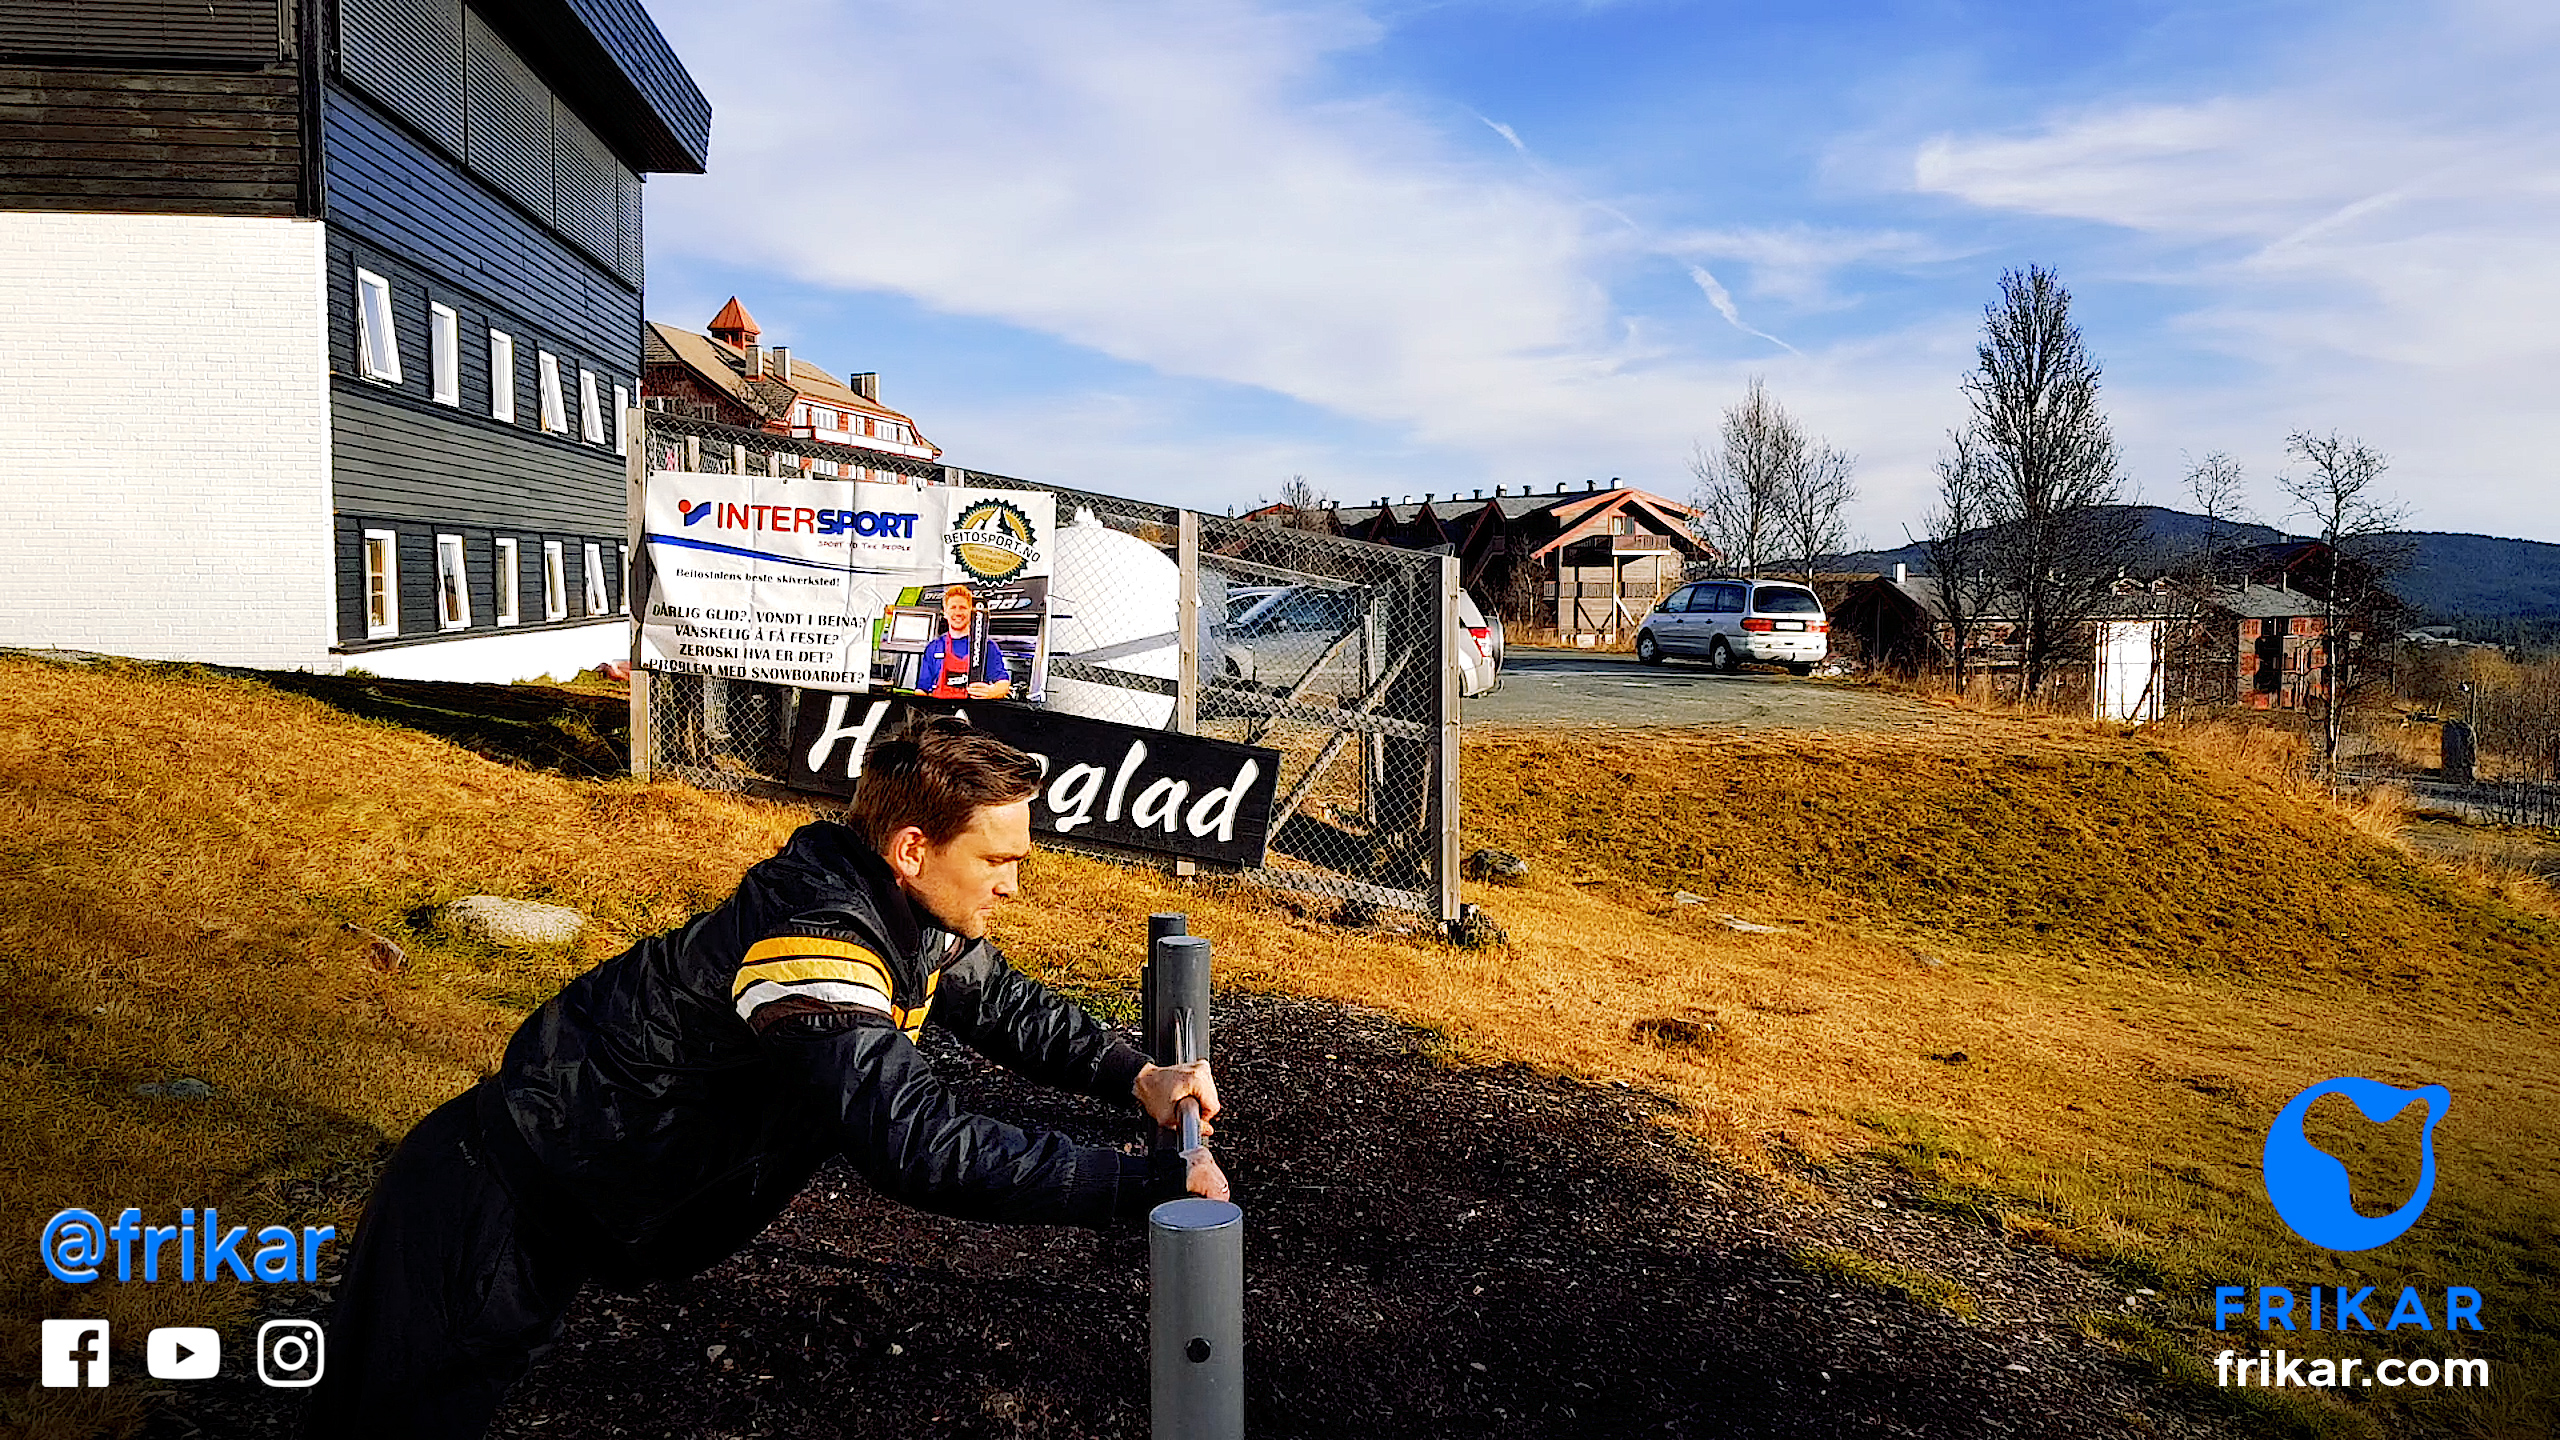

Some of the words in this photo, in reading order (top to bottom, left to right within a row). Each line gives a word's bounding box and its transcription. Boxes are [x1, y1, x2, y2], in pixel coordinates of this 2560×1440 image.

[717, 502, 919, 539] INTERSPORT
[943, 531, 1041, 563] BEITOSPORT.NO
[745, 572, 773, 583] beste
[776, 575, 840, 587] skiverksted!
[652, 602, 701, 618] DÅRLIG
[756, 611, 802, 625] VONDT
[808, 614, 813, 626] I
[818, 614, 866, 628] BEINA?
[674, 624, 751, 641] VANSKELIG
[754, 626, 764, 641] Å
[769, 627, 786, 642] FÅ
[790, 630, 840, 645] FESTE?
[679, 643, 739, 659] ZEROSKI
[743, 648, 771, 660] HVA
[776, 649, 794, 661] ER
[798, 651, 834, 664] DET?
[649, 658, 712, 676] PROBLEM
[717, 663, 747, 678] MED
[751, 666, 865, 684] SNOWBOARDET?
